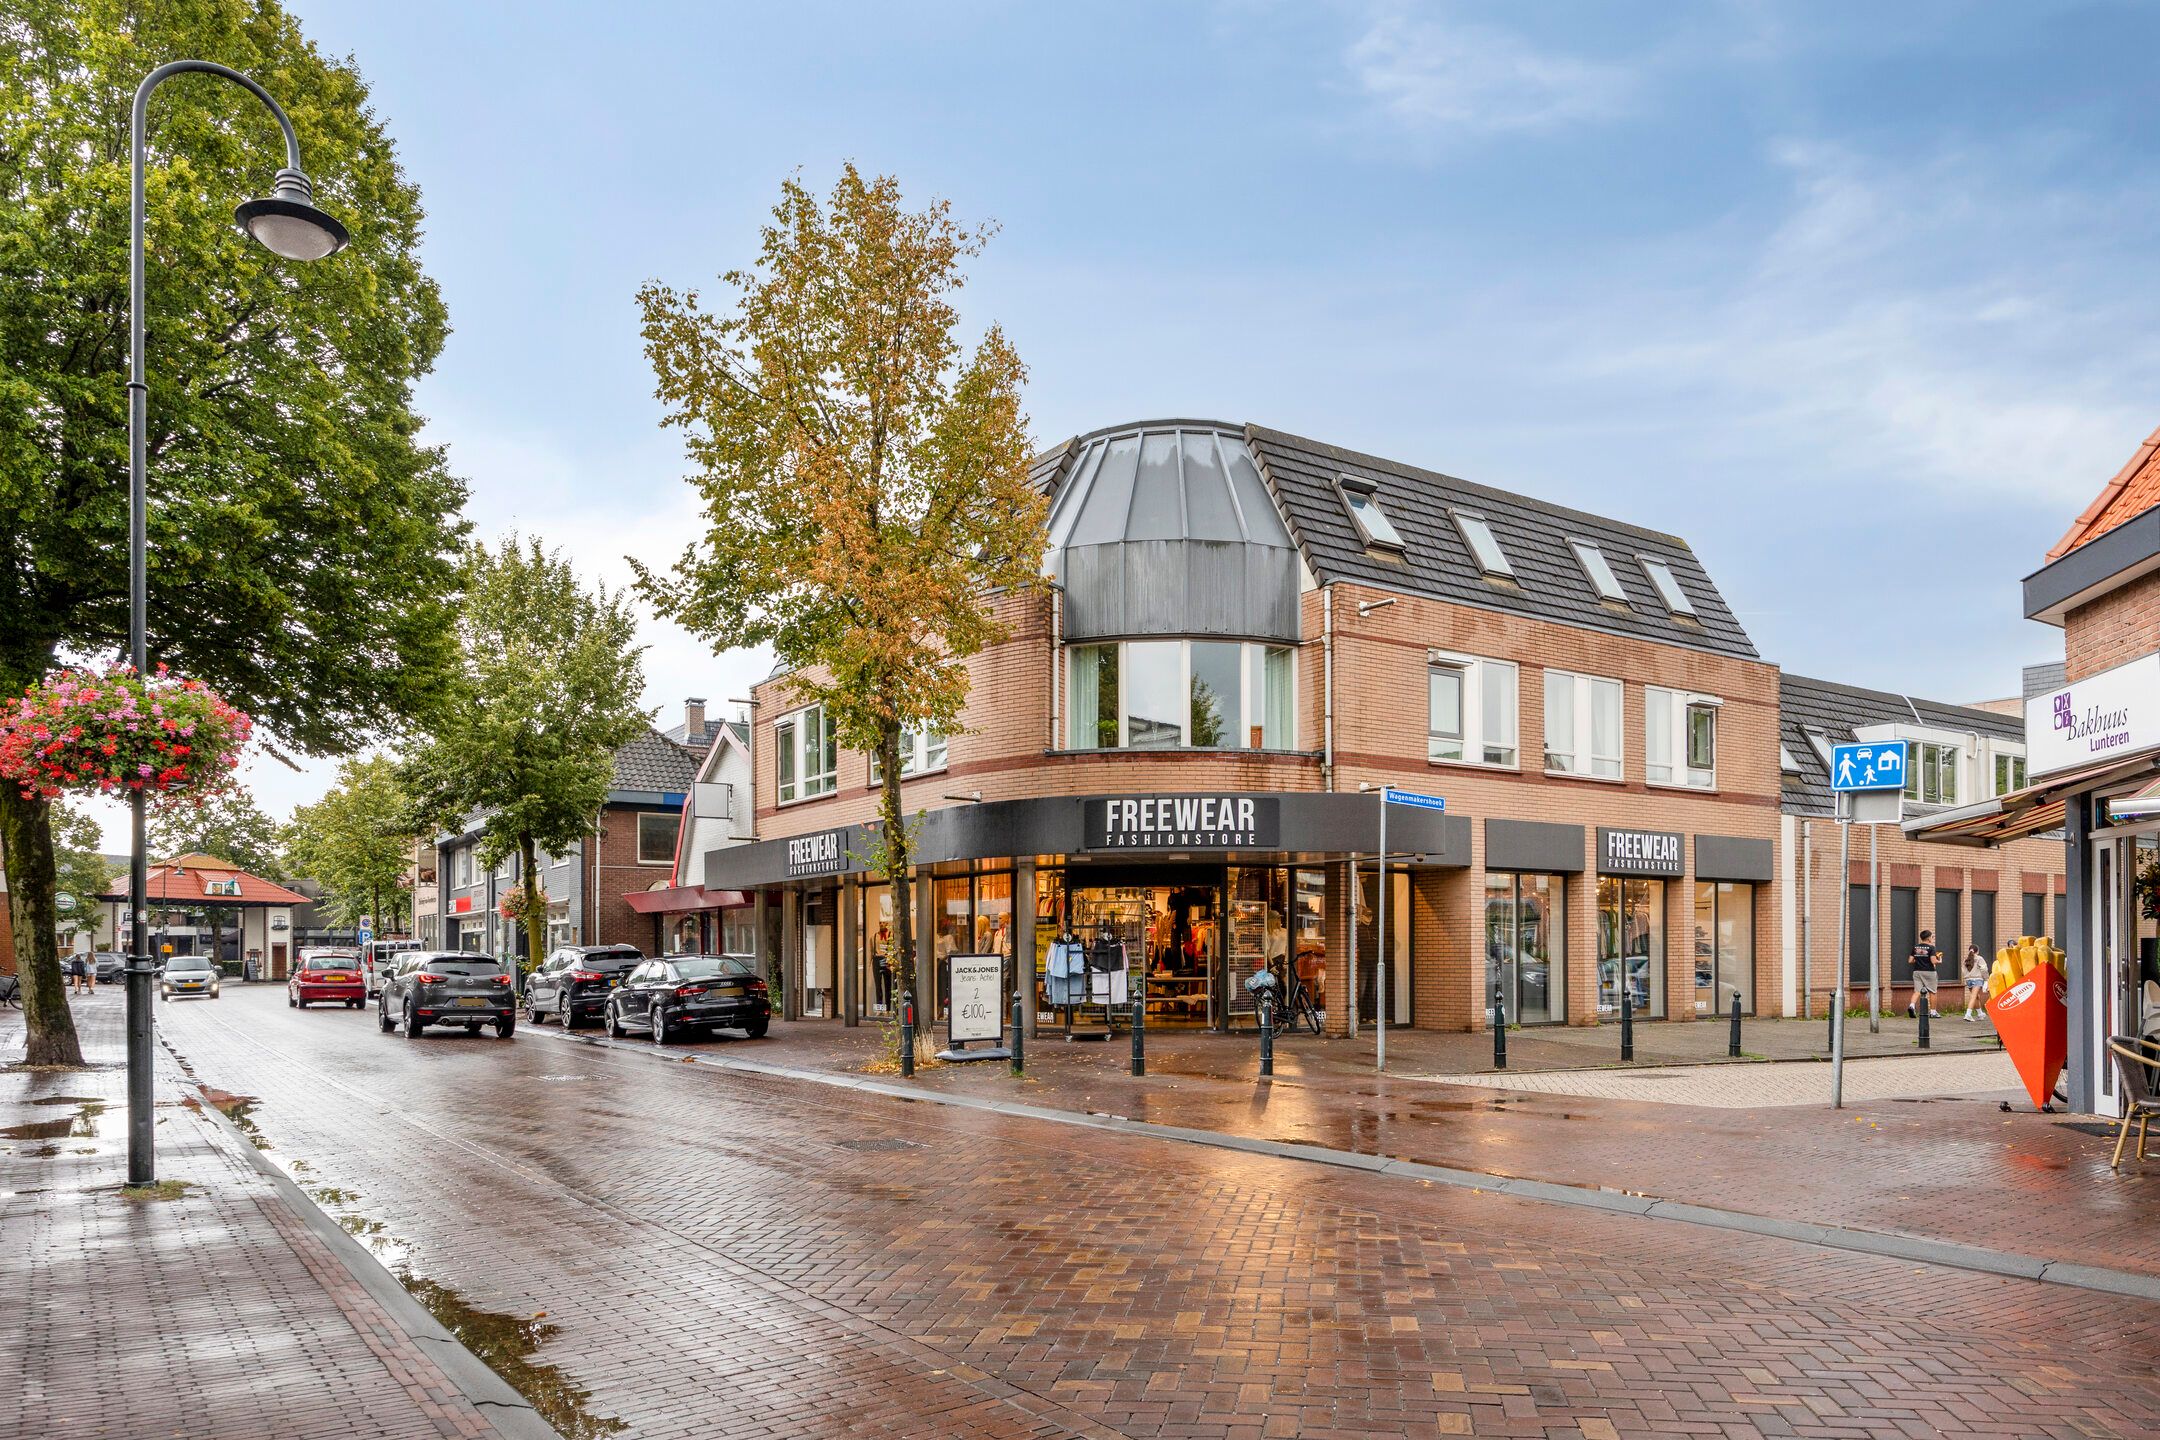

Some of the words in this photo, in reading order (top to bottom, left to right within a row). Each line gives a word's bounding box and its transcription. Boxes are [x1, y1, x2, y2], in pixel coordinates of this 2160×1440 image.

[2067, 705, 2128, 741] Bakhuus
[2090, 731, 2129, 752] Lunteren
[1388, 792, 1443, 806] Wagenmakershoek
[1106, 798, 1255, 832] FREEWEAR
[1106, 834, 1255, 846] FASHIONSTORE
[1608, 832, 1678, 860] FREEWEAR
[789, 833, 838, 865] FREEWEAR
[789, 861, 838, 875] FASHIONSTORE
[1608, 859, 1678, 871] FASHIONSTORE
[974, 988, 979, 999] 2
[1036, 1011, 1054, 1020] EWEAR
